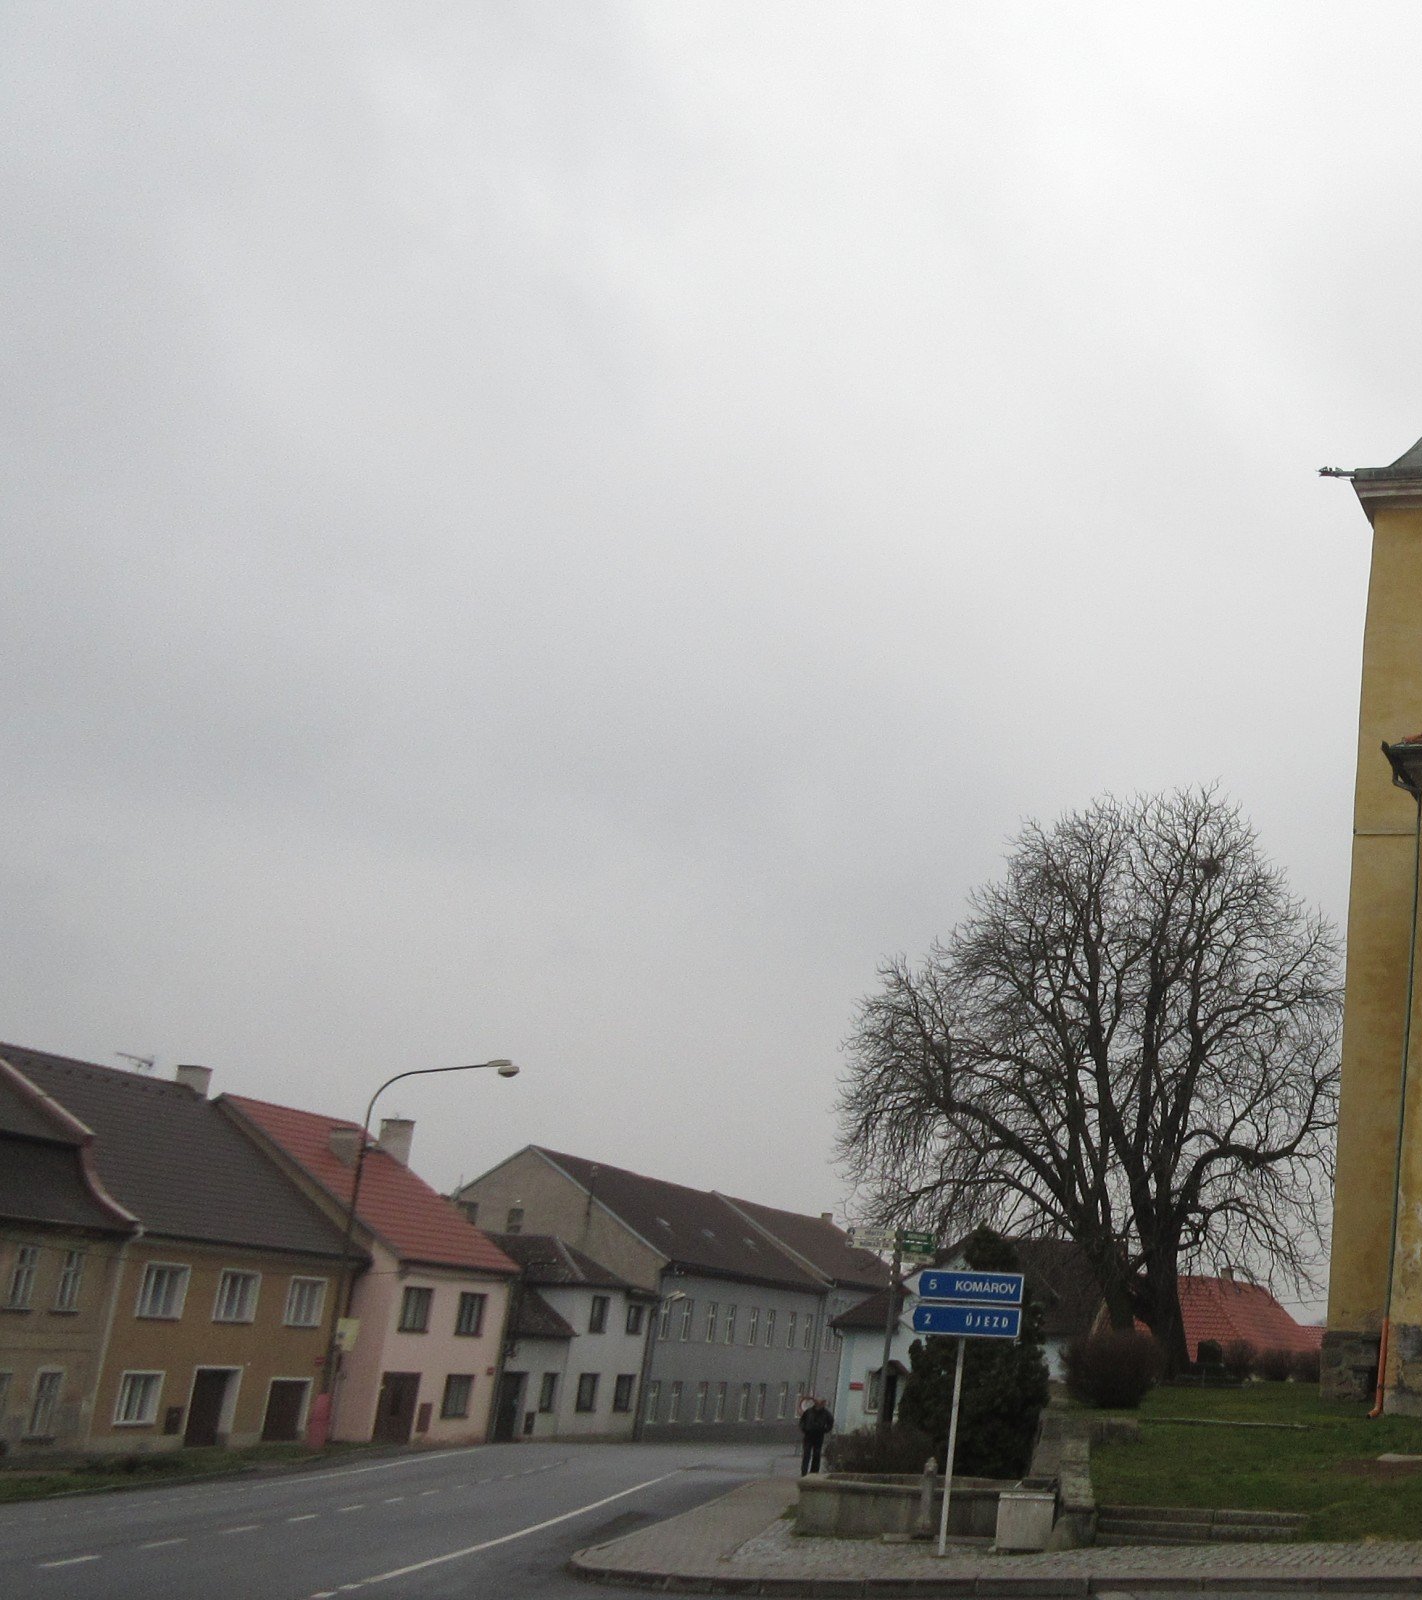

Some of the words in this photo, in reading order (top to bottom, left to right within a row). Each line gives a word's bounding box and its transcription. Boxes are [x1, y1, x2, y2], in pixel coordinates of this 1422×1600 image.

[929, 1279, 938, 1290] 5
[954, 1278, 1017, 1295] KOMÁROV
[923, 1313, 932, 1325] 2
[965, 1313, 1010, 1328] ÚJEZD
